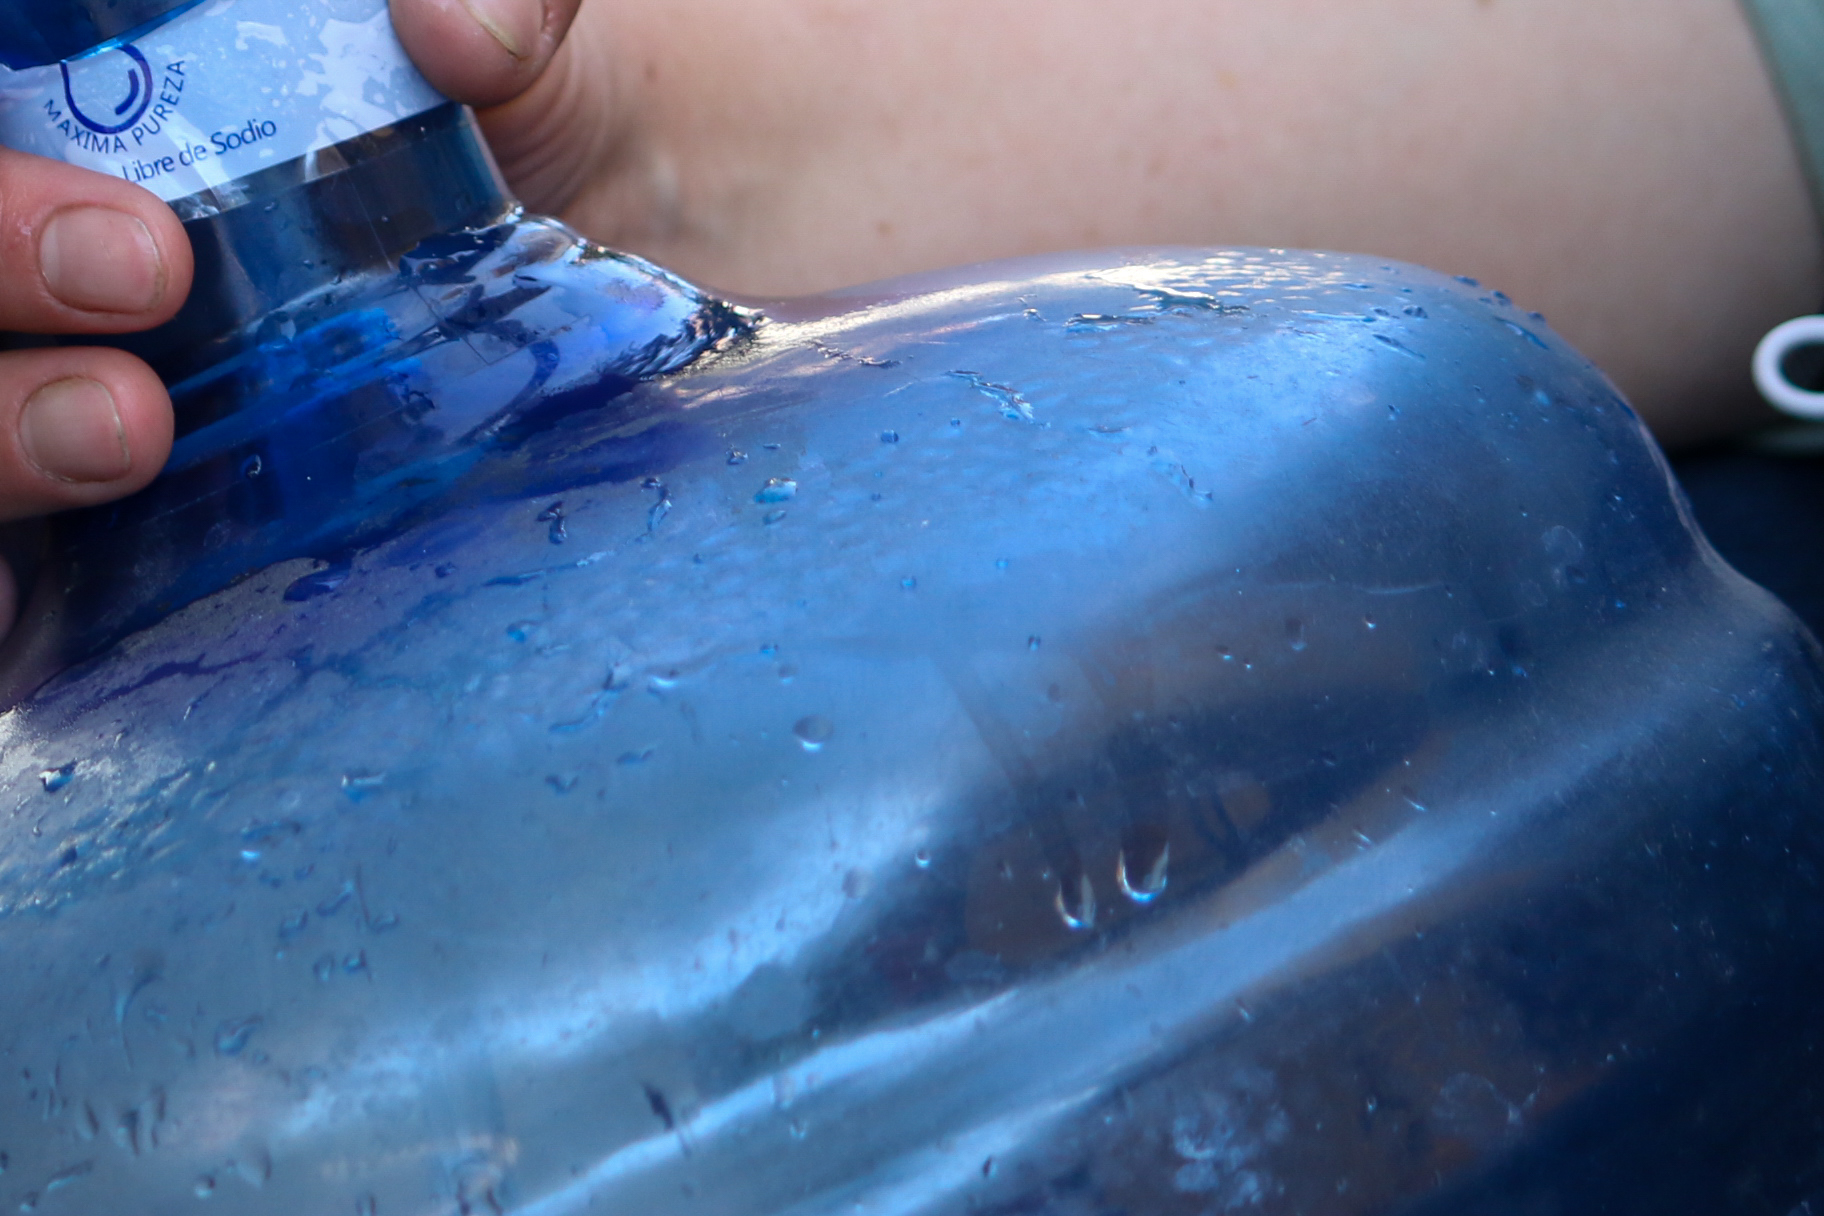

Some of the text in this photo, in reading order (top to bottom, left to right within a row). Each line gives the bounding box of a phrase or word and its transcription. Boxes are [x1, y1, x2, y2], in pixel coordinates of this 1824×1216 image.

[43, 59, 186, 154] MAXIMA PUREZA
[122, 118, 277, 183] Libre de Sodio
